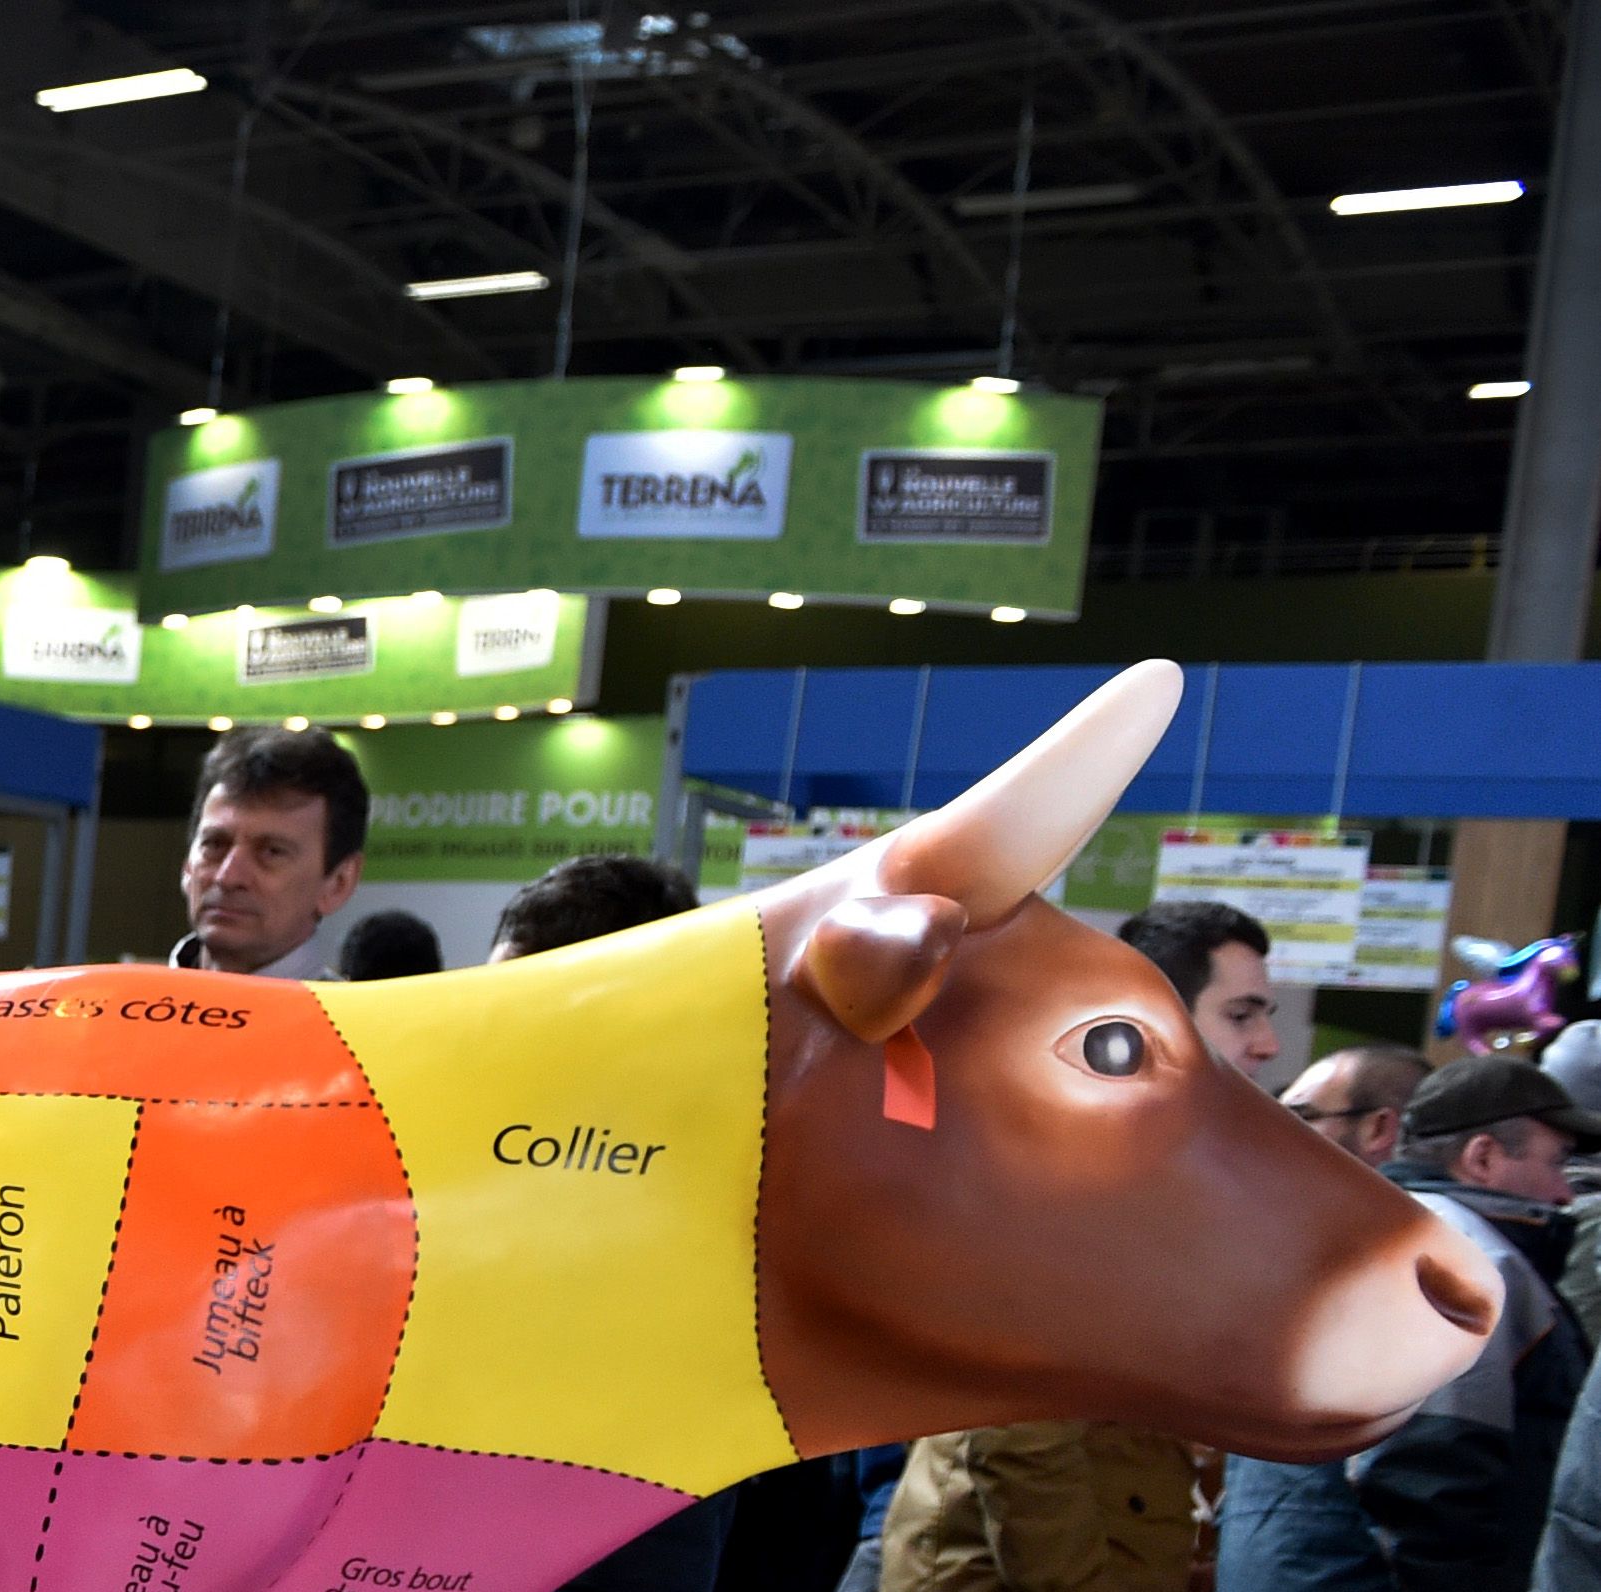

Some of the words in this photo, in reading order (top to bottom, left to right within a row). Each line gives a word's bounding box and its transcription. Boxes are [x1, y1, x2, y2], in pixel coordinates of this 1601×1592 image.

[602, 472, 766, 509] TERRENA
[537, 791, 654, 827] POUR
[120, 996, 252, 1029] côtes
[493, 1124, 666, 1175] Collier
[213, 1205, 245, 1226] à
[193, 1234, 241, 1376] Jumeau
[227, 1238, 275, 1362] bifteck
[138, 1513, 171, 1539] à
[340, 1556, 406, 1591] Gros
[408, 1566, 472, 1592] bout
